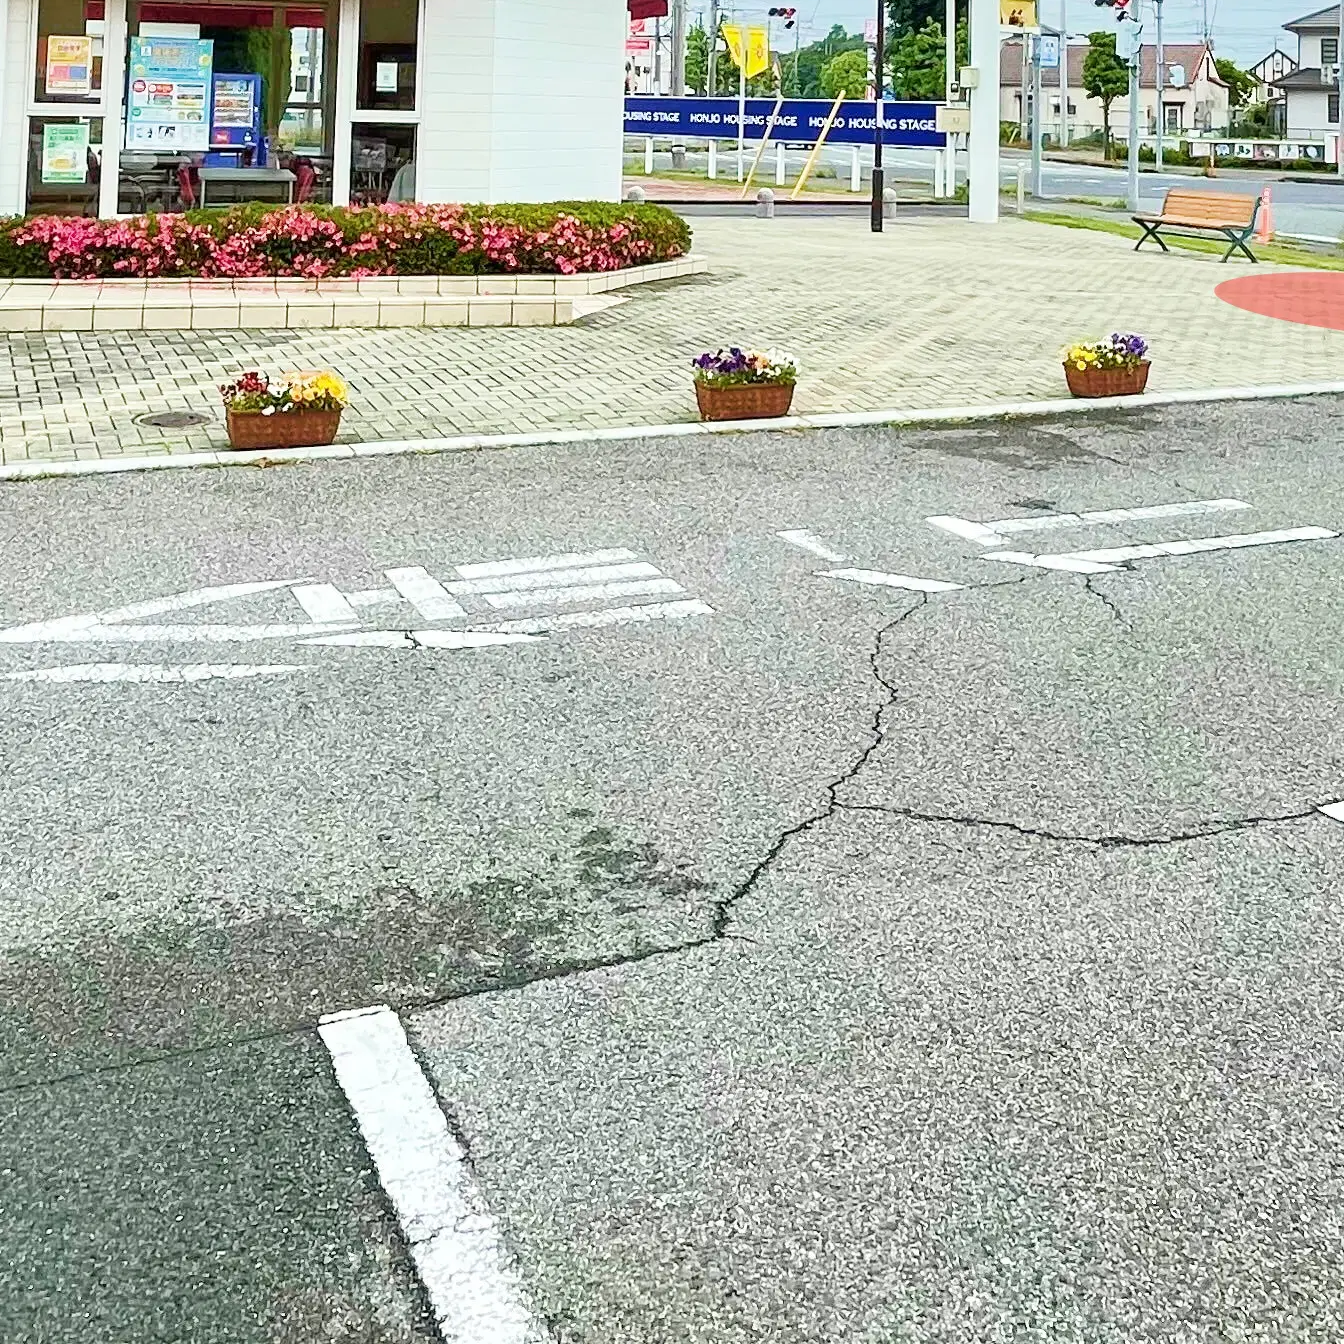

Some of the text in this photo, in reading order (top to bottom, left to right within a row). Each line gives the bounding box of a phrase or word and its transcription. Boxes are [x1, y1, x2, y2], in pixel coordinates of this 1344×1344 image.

[622, 111, 652, 122] OUSING
[652, 111, 681, 123] STAGE
[689, 113, 721, 124] HONJO
[848, 117, 897, 130] HOUSNG
[899, 119, 936, 131] STAGE
